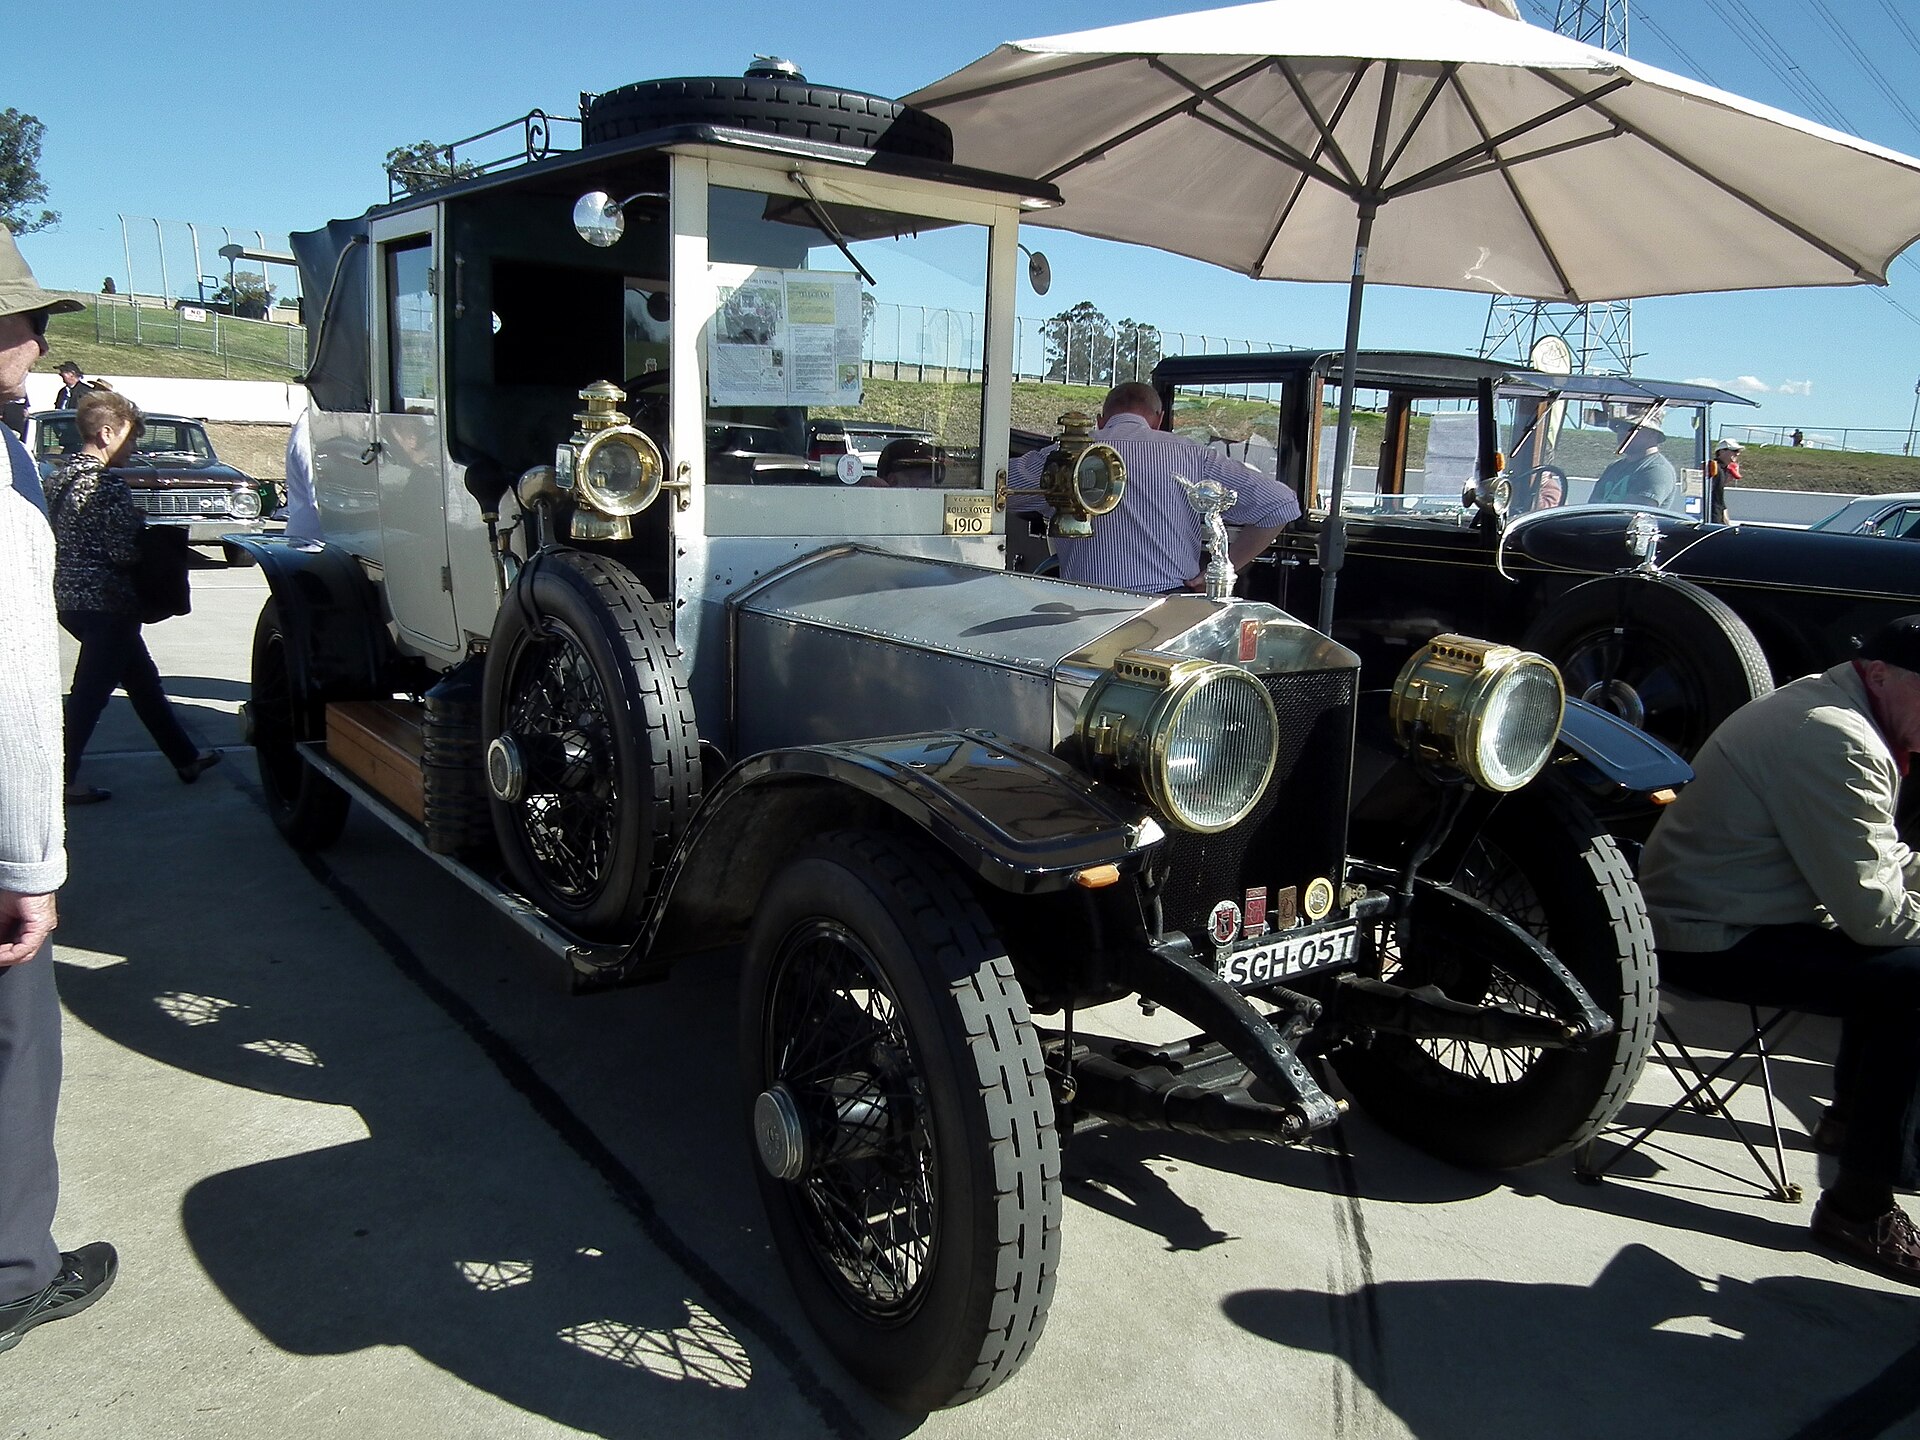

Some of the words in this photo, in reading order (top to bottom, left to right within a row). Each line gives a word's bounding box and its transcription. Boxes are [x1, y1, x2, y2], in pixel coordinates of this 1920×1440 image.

[947, 506, 968, 514] ROLLS
[969, 506, 991, 514] ROYCE
[954, 518, 983, 533] 1910
